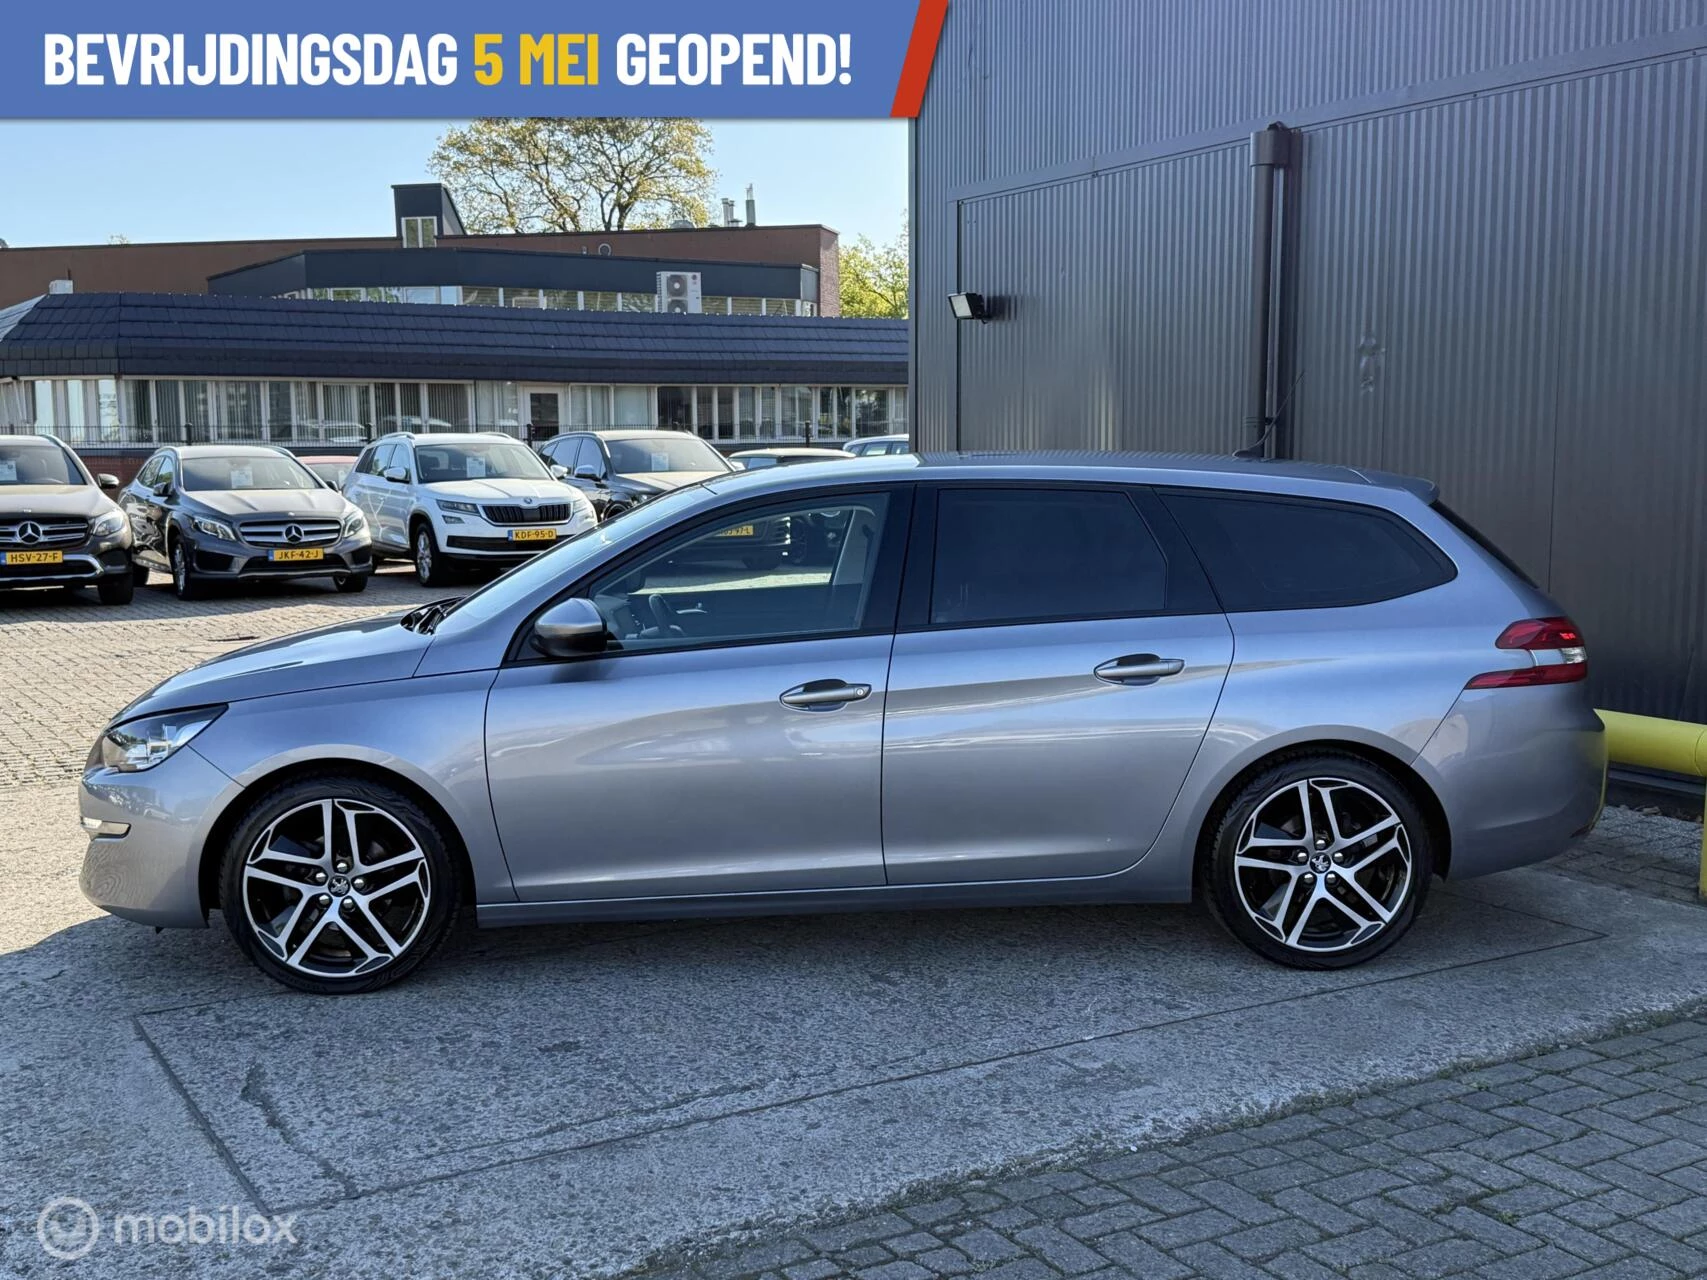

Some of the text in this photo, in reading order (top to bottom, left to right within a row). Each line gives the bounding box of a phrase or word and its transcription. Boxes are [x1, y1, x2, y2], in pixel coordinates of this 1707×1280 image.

[514, 530, 554, 540] KDF-95-D
[10, 552, 59, 563] HSV-27-F
[278, 550, 319, 560] JKF-42-J
